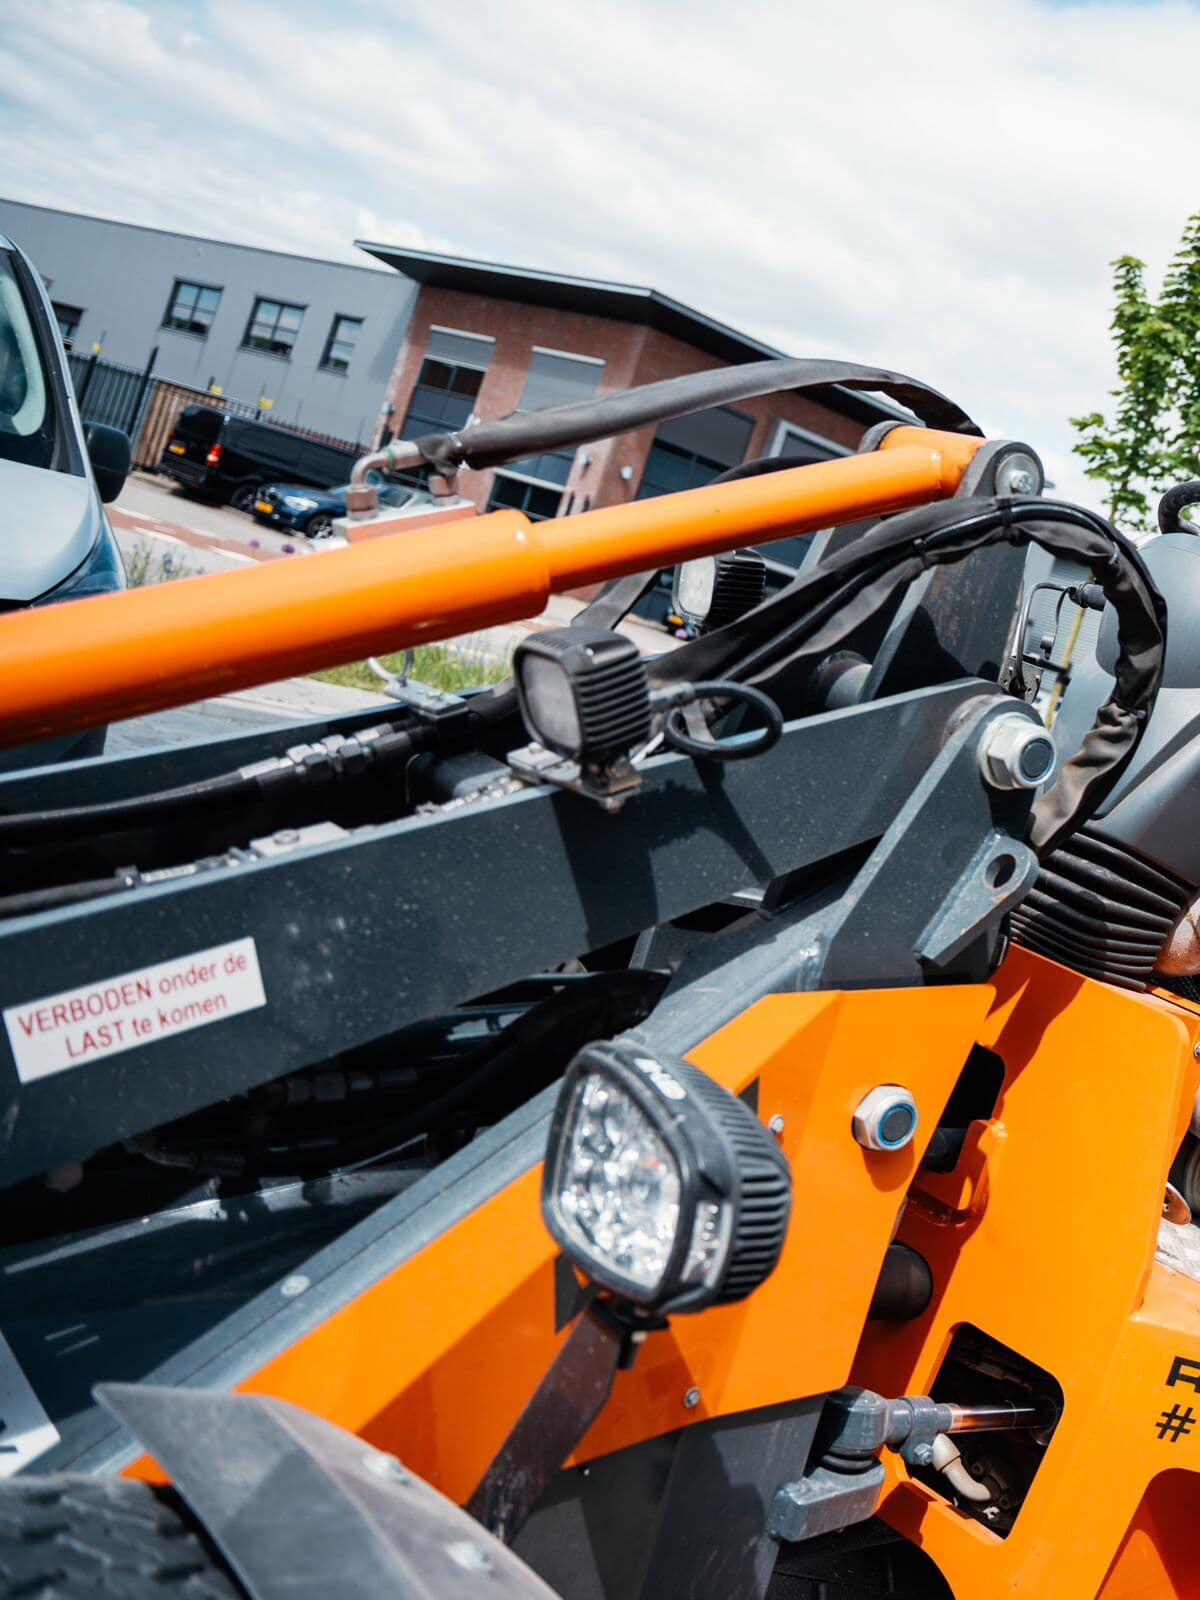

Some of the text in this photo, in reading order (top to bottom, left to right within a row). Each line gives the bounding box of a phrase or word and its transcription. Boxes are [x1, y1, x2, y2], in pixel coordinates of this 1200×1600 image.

[18, 952, 248, 1037] VERBODEN onder de
[65, 992, 228, 1058] LAST te komen
